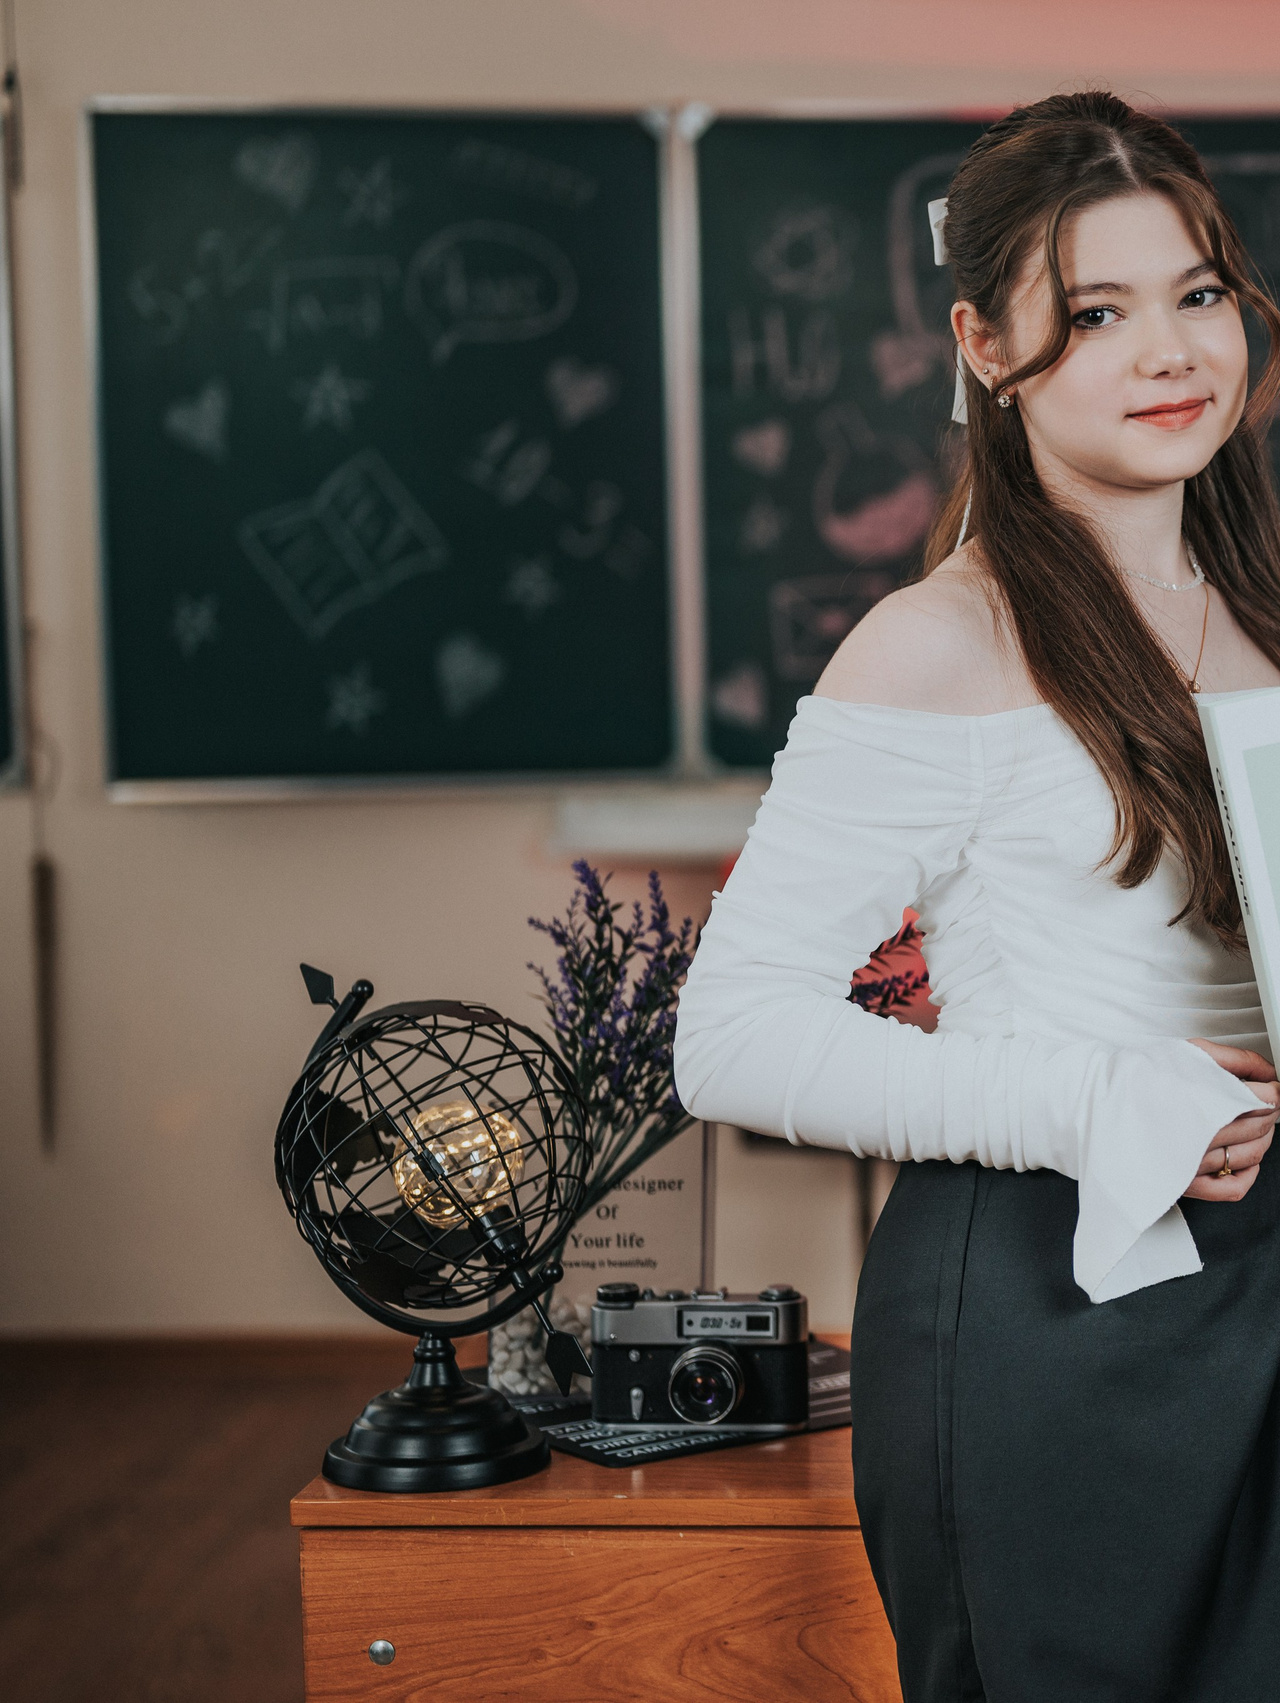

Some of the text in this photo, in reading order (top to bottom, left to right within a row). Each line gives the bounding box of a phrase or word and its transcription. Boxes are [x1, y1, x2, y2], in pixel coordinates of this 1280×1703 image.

[596, 1203, 619, 1220] Of
[570, 1232, 646, 1249] Your life
[562, 1260, 596, 1270] rawing
[592, 1429, 686, 1451] DIRECTO
